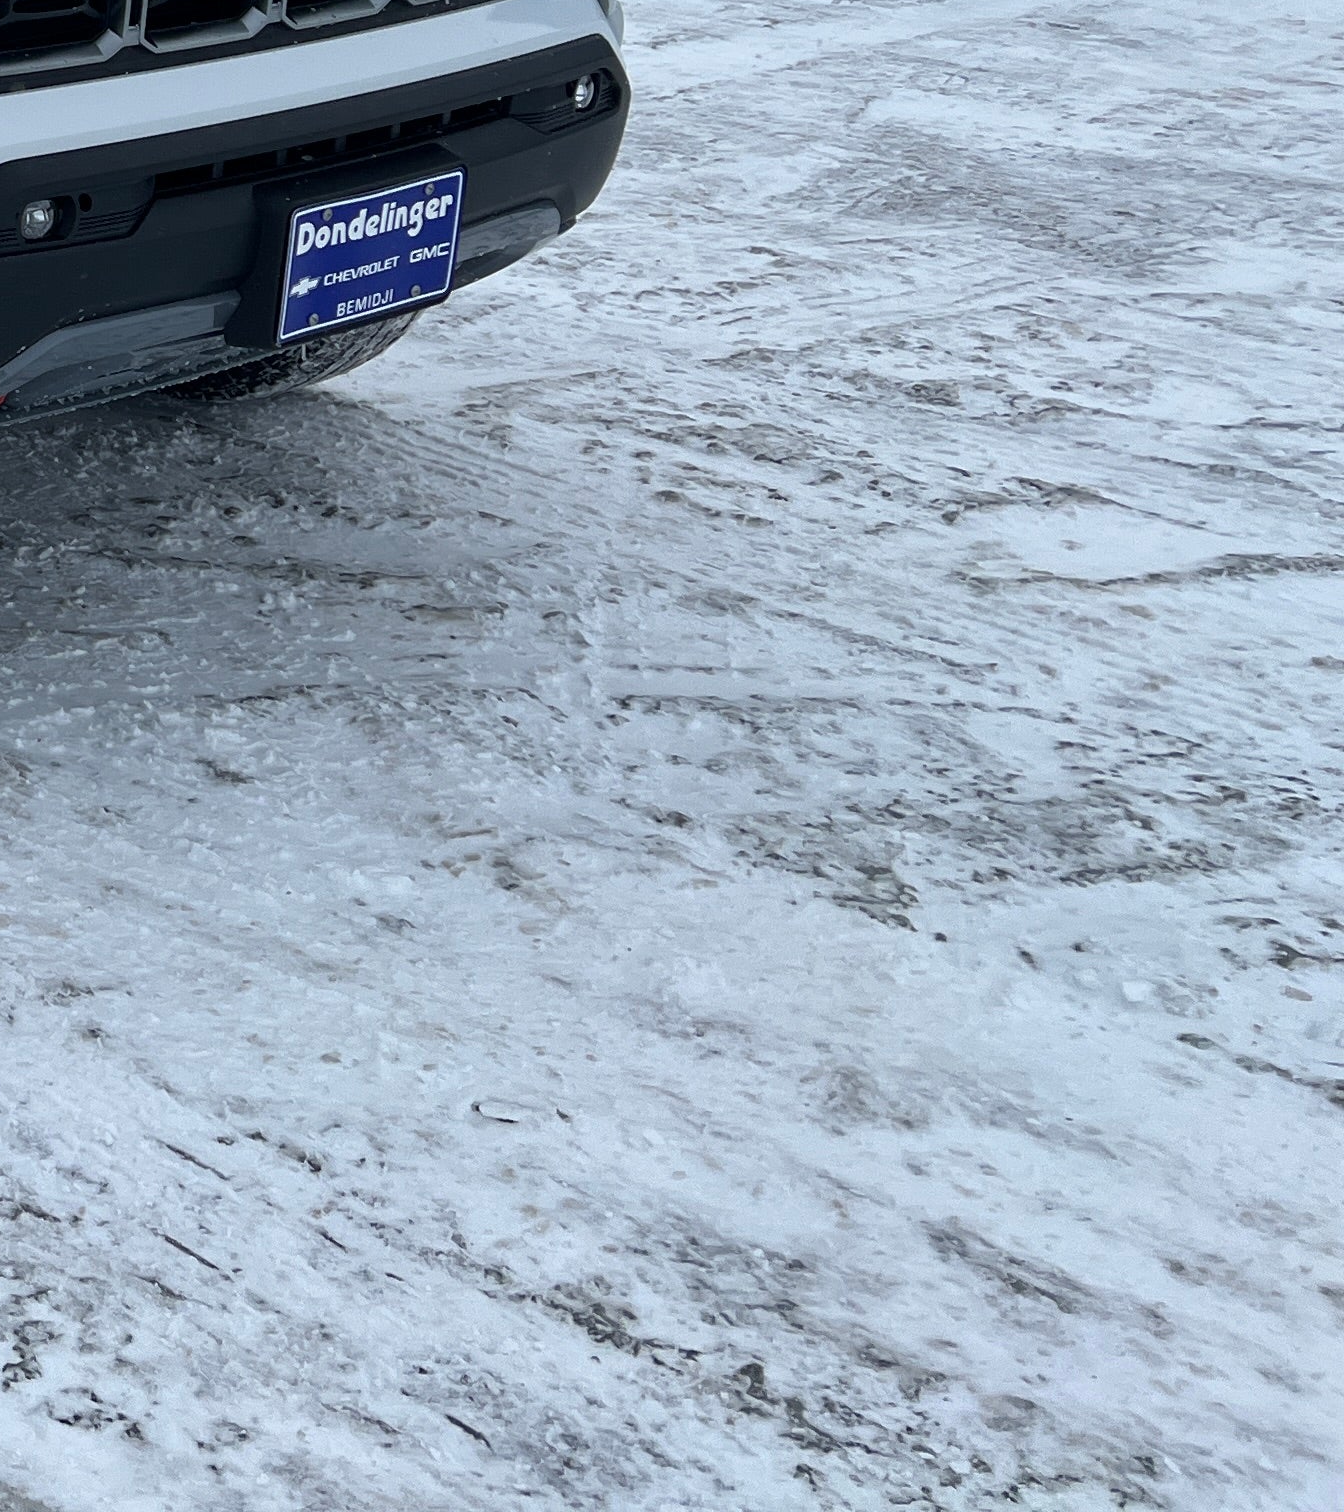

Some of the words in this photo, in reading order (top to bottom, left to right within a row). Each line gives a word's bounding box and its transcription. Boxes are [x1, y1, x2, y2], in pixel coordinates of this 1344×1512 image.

[295, 194, 454, 257] Dondelinger
[323, 255, 400, 286] CHEVROLET
[409, 242, 451, 264] GMC
[336, 288, 394, 318] BEMIDJI
